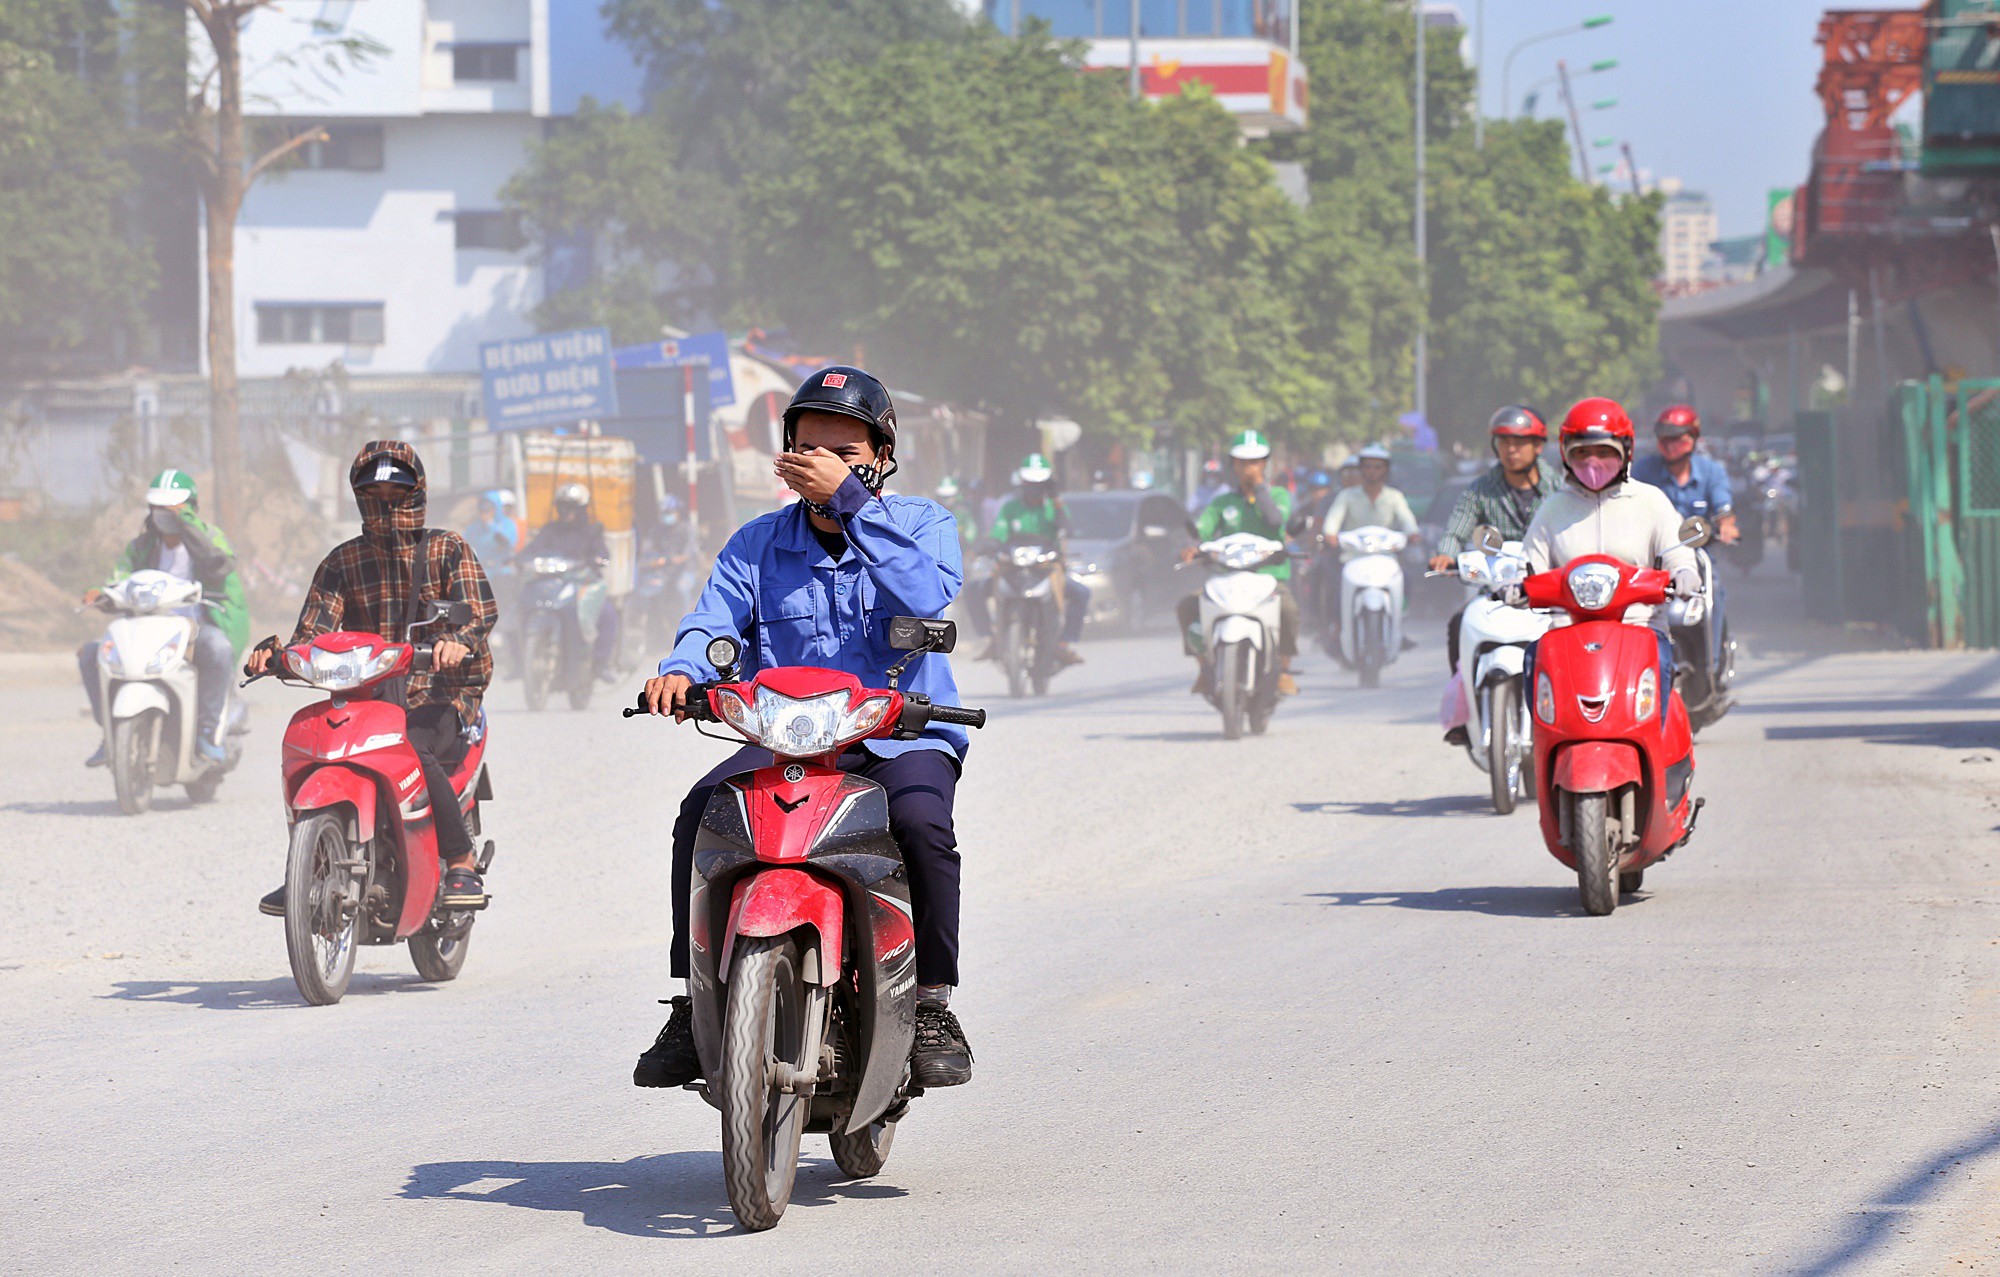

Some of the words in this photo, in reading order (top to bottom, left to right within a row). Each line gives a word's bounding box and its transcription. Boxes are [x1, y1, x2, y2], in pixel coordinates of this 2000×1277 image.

[484, 340, 547, 371] BỆNH
[550, 331, 604, 362] VIỆN
[398, 767, 420, 791] YAMAHA
[880, 938, 909, 962] 110
[890, 974, 916, 998] YAMAHA
